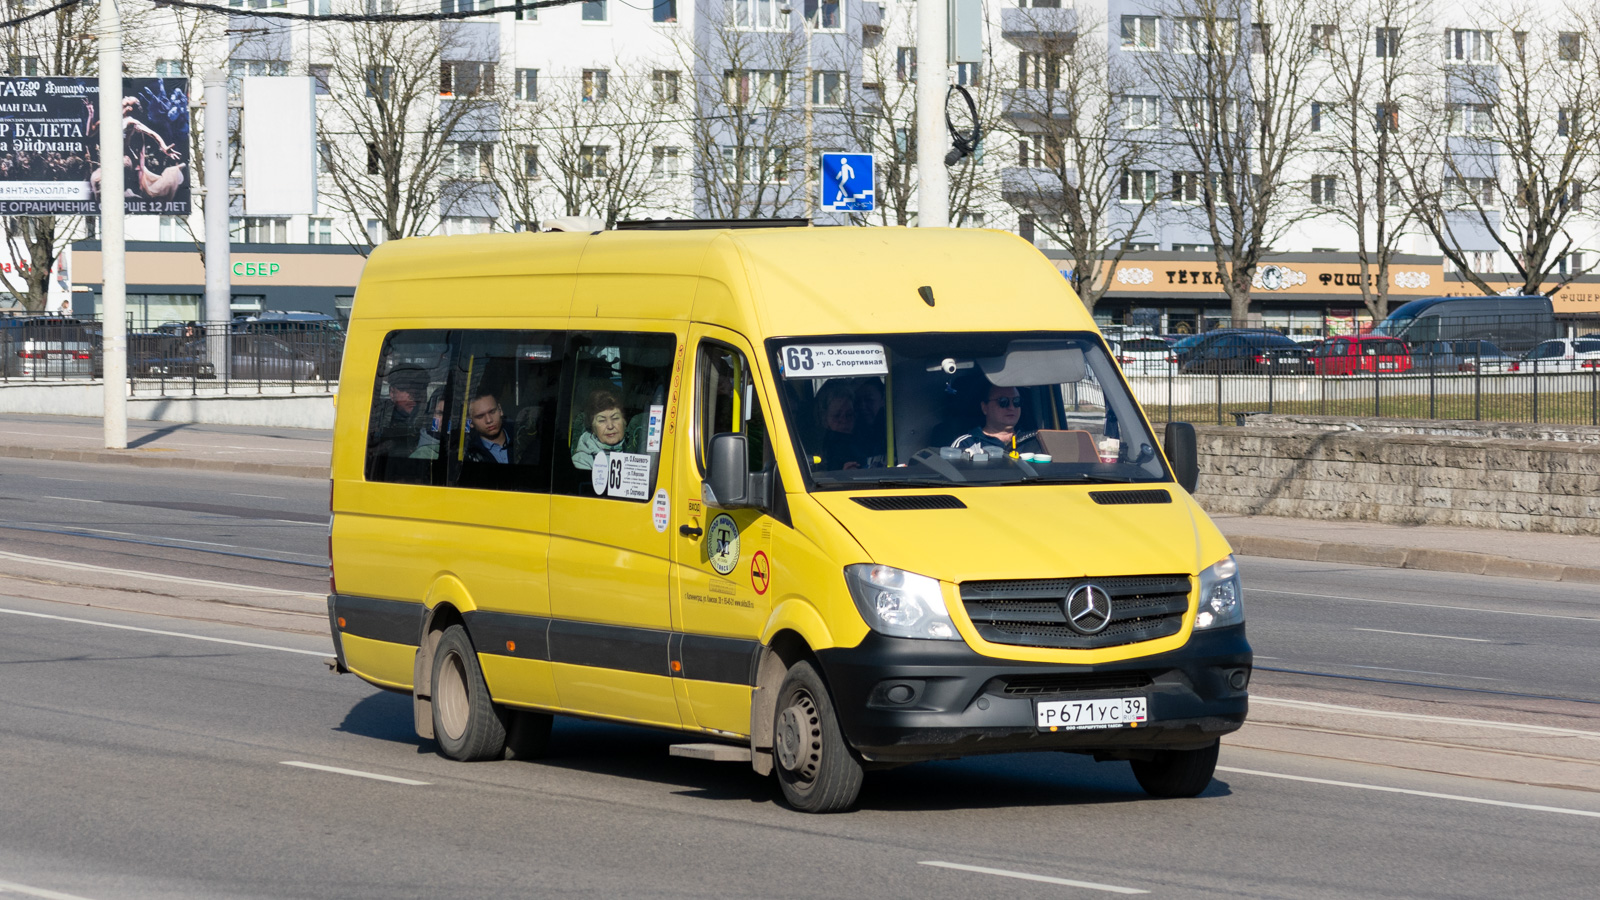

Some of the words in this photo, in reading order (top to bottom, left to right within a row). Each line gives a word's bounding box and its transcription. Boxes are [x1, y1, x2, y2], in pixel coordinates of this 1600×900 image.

[16, 81, 40, 91] 17:00
[45, 80, 85, 97] Янтарь
[22, 103, 48, 112] ГАЛА
[15, 123, 83, 138] БАЛЕТА
[13, 138, 83, 154] Эйфмана
[5, 186, 80, 195] ЯНТАРЬХОЛЛ.РФ
[9, 202, 96, 212] ОГРАНИЧЕНИЕ
[149, 202, 163, 212] 12
[164, 202, 187, 212] ЛЕТ
[232, 262, 280, 276] СБЕР
[786, 347, 814, 371] 63
[822, 360, 834, 368] ул.
[836, 359, 883, 367] Спортивная
[609, 458, 622, 489] 63
[1046, 702, 1119, 724] Р671УС
[1124, 700, 1141, 714] 39
